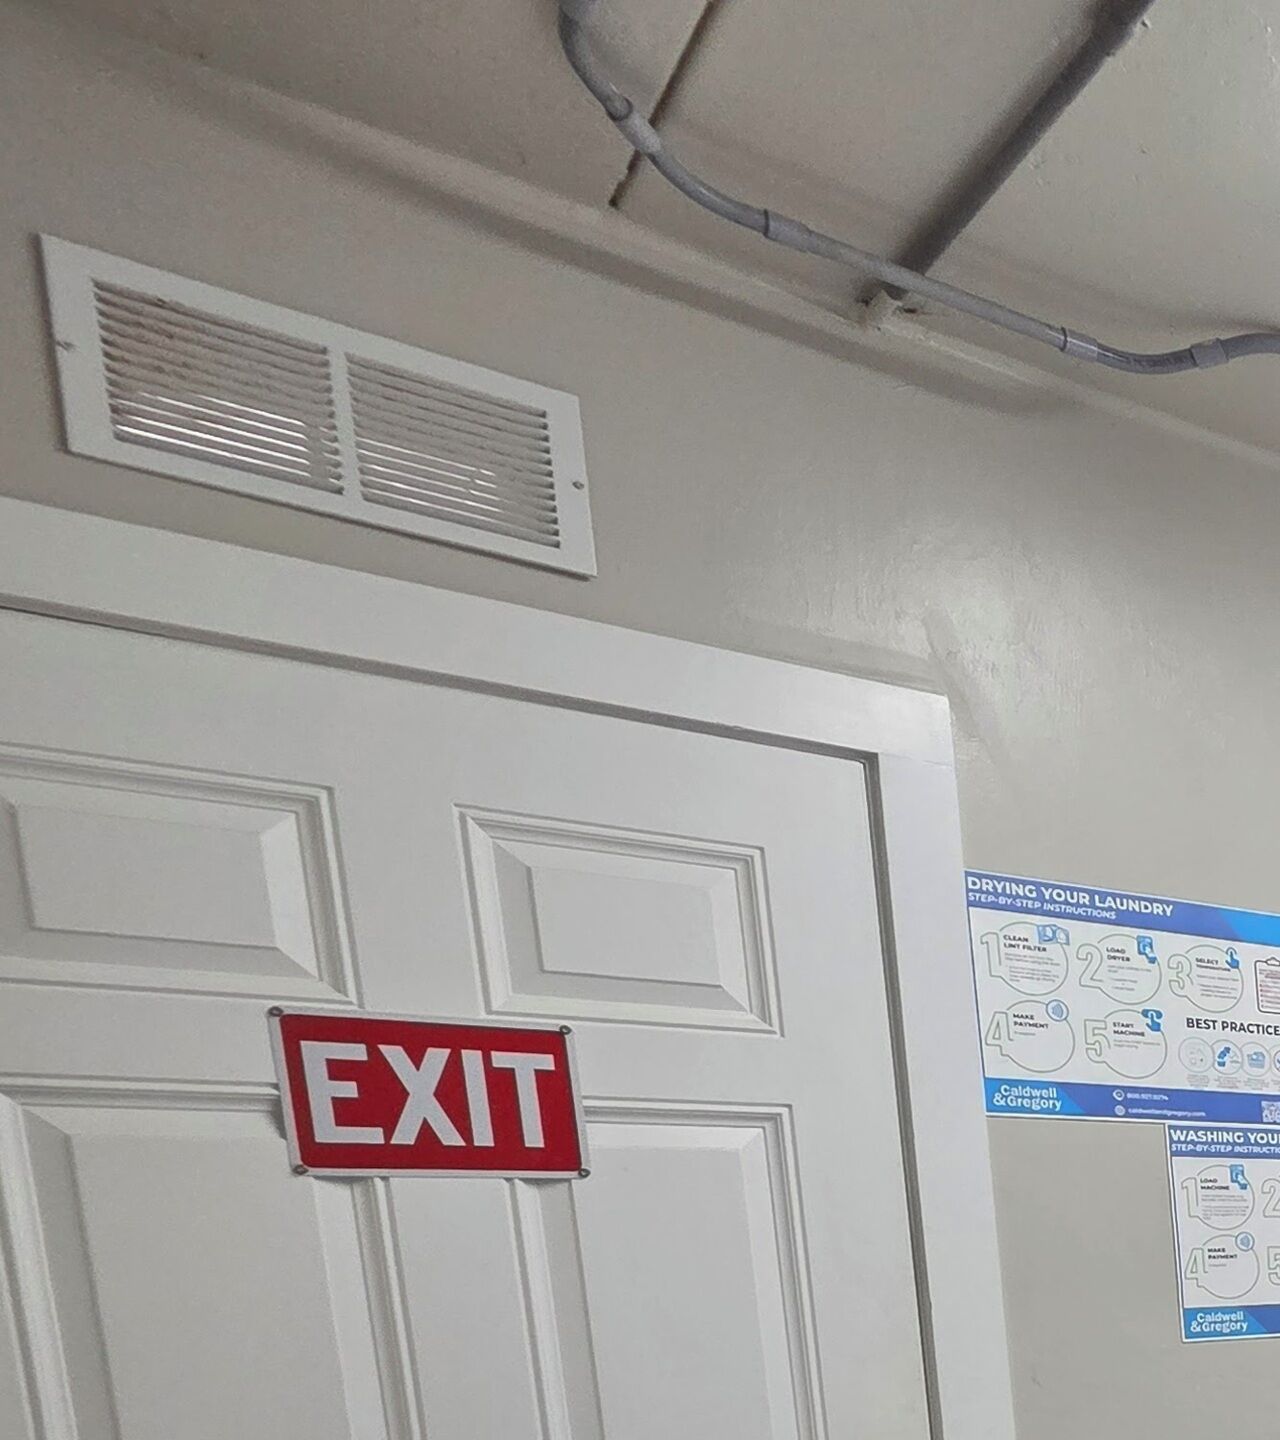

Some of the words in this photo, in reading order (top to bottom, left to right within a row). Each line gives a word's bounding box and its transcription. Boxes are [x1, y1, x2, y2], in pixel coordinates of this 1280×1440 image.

[967, 876, 1037, 898] DRYING
[1041, 886, 1090, 905] YOUR
[1094, 894, 1173, 917] LAUNDRY
[968, 892, 1042, 909] STEP-BY-STEP
[1043, 902, 1117, 919] INSTRUCTIONS
[1106, 946, 1126, 955] LOAD
[1013, 1021, 1049, 1029] PAYMENT
[1186, 1017, 1218, 1031] BEST
[1113, 1029, 1146, 1038] MACHINE
[300, 1040, 555, 1149] EXIT
[1000, 1084, 1057, 1098] Caldwell
[993, 1092, 1062, 1112] &Gregory
[1170, 1129, 1244, 1143] WASHING
[1171, 1143, 1232, 1152] STEP-BY-STEP
[1196, 1311, 1244, 1322] Caldwell
